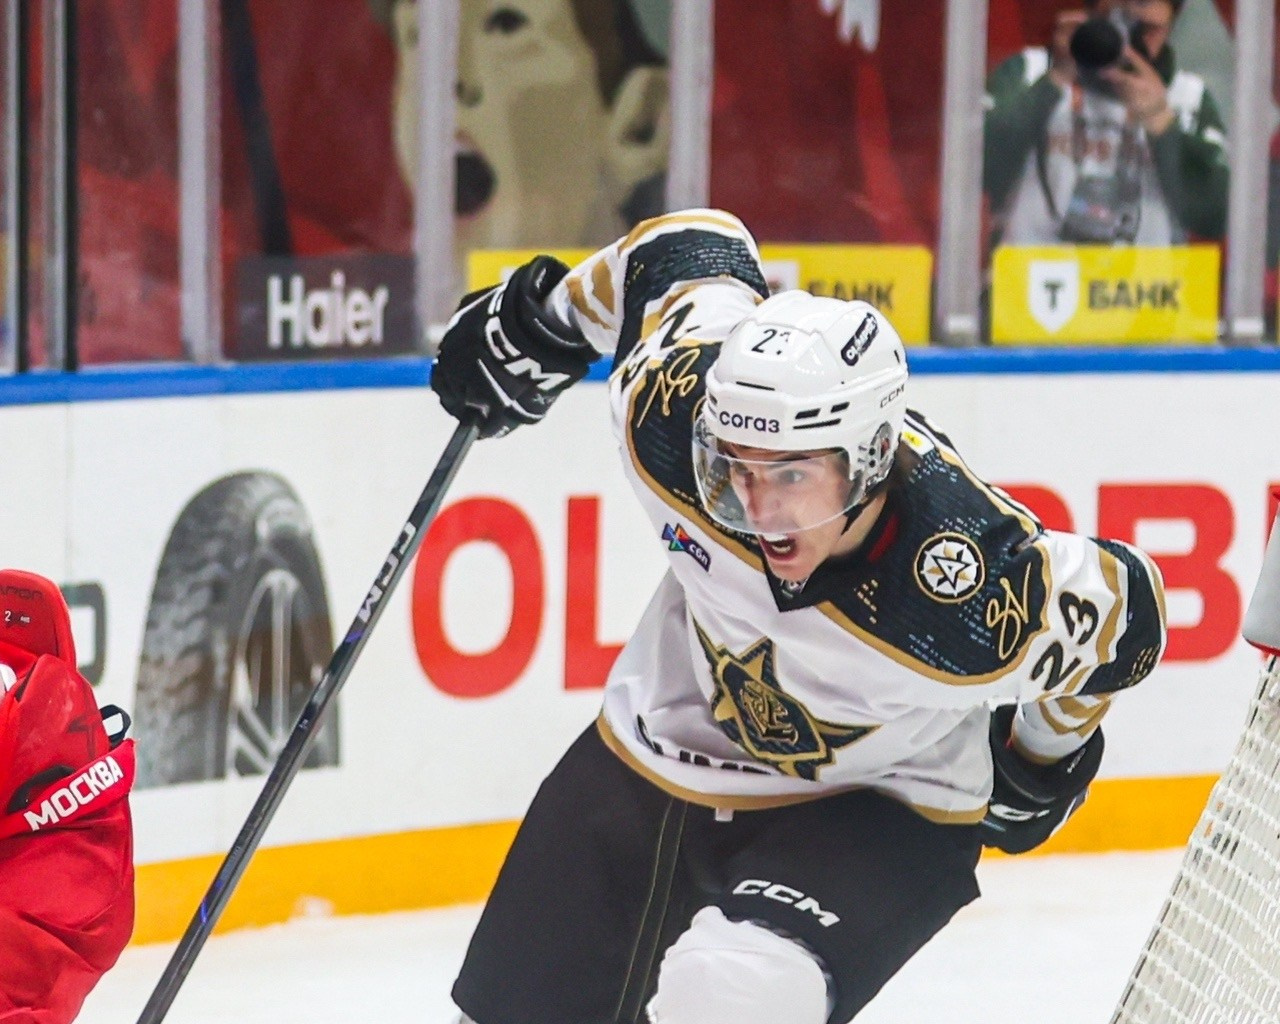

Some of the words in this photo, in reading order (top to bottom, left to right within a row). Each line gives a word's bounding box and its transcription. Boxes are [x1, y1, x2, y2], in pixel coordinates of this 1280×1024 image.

[267, 271, 390, 348] Haier
[1088, 279, 1180, 312] БАНК
[880, 384, 905, 408] CCM
[719, 410, 780, 433] согаз
[1030, 591, 1100, 691] 23
[23, 755, 124, 832] МОСКВА
[732, 879, 841, 928] CCM
